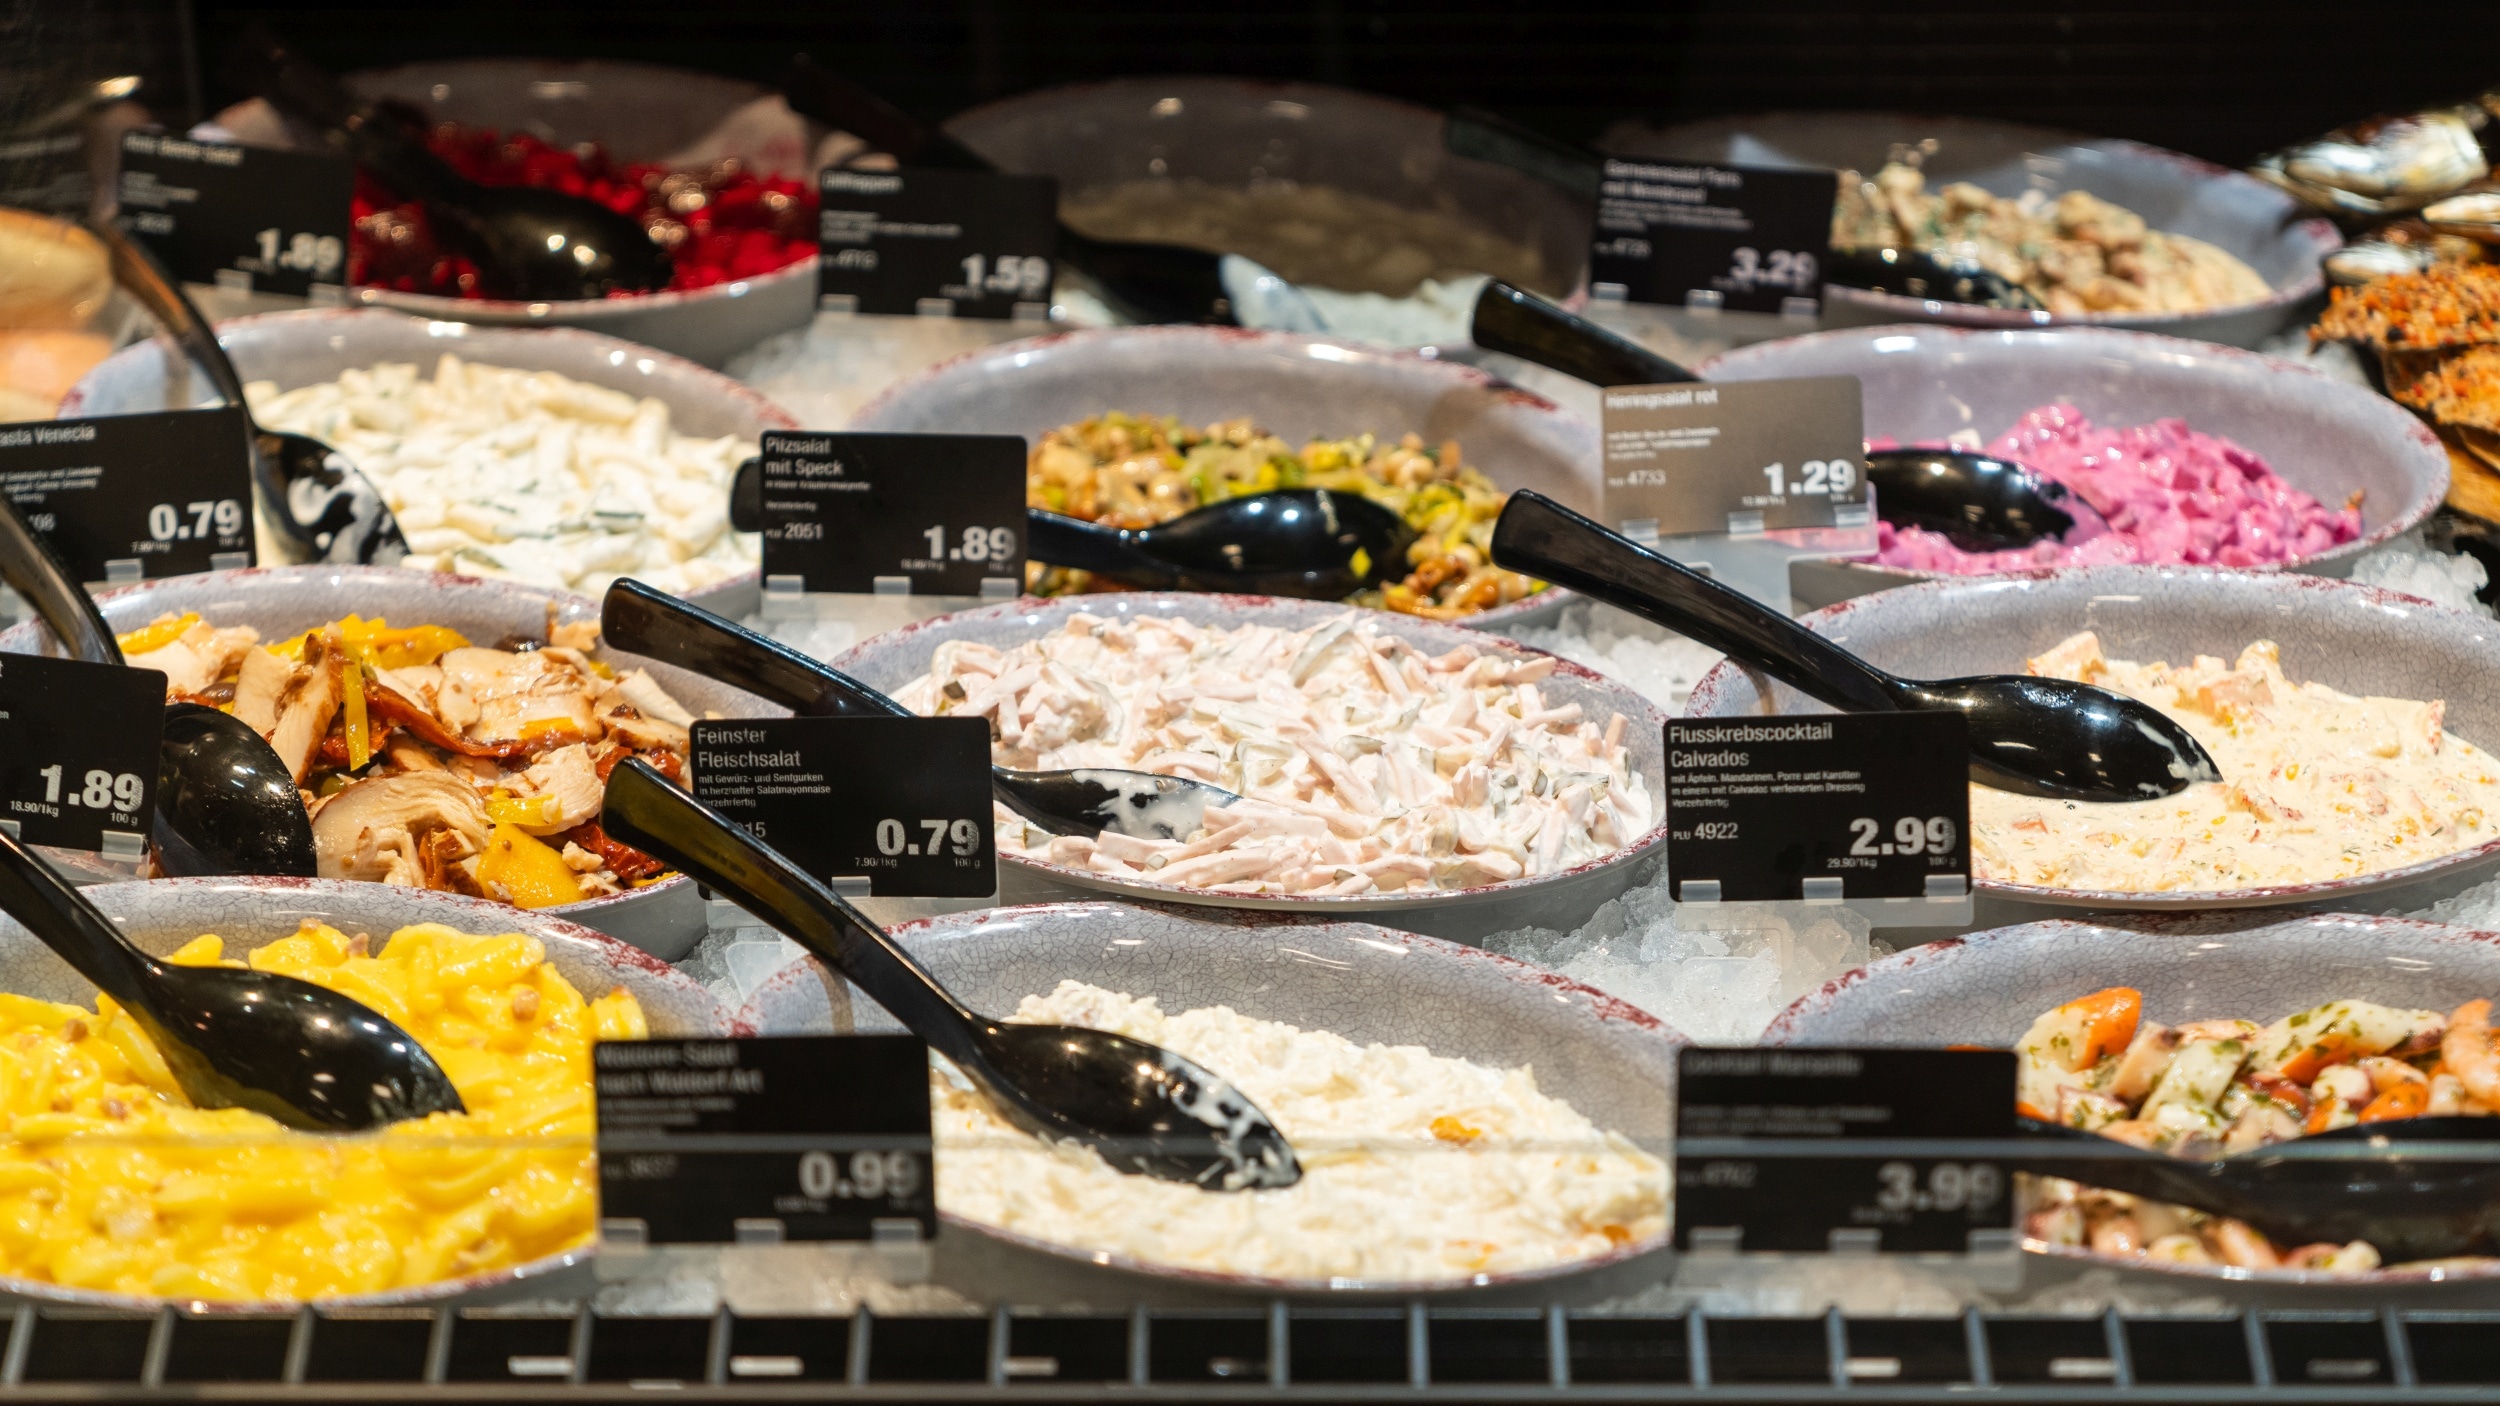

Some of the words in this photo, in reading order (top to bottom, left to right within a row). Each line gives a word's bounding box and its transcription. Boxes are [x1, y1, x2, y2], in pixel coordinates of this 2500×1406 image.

[256, 228, 343, 272] 1.89
[961, 253, 1050, 292] 1.59
[1730, 246, 1819, 290] 3.29
[1696, 388, 1718, 404] rot
[0, 430, 33, 447] asta
[34, 424, 97, 444] Venecia
[766, 436, 832, 454] Pilzsalat
[766, 458, 792, 475] mit
[795, 458, 844, 478] Speck
[1764, 459, 1856, 495] 1.29
[149, 499, 243, 541] 0.79
[784, 522, 823, 539] 2051
[923, 525, 1016, 561] 1.89
[697, 727, 767, 744] Feinster
[1670, 722, 1833, 744] Flusskrebscocktail
[698, 750, 801, 768] Fleischsalat
[1671, 750, 1750, 768] Calvados
[699, 775, 713, 783] mit
[715, 773, 752, 784] Gewürz-
[754, 774, 771, 783] und
[773, 773, 824, 784] Senfgurken
[1671, 774, 1687, 784] mit
[1803, 770, 1821, 780] und
[1823, 769, 1861, 780] Karotten
[40, 764, 144, 812] 1.89
[700, 786, 708, 795] in
[710, 785, 755, 795] herzhafter
[757, 784, 831, 796] Salatmayonnaise
[1682, 786, 1710, 795] einem
[1711, 785, 1727, 794] mit
[1728, 784, 1769, 794] Calvados
[1770, 783, 1824, 793] verfeinerten
[1825, 782, 1866, 793] Dressing
[10, 800, 59, 818] 18.90/1kg
[111, 812, 129, 824] 100
[131, 817, 138, 826] g
[876, 818, 980, 856] 0.79
[1673, 831, 1692, 840] PLU
[1694, 822, 1739, 840] 4922
[1849, 816, 1957, 856] 2.99
[855, 857, 897, 869] 7.90/1kg
[974, 860, 980, 869] g
[1827, 857, 1878, 870] 29.90/1kg
[799, 1150, 920, 1199] 0.99
[1878, 1159, 2004, 1212] 3.99
